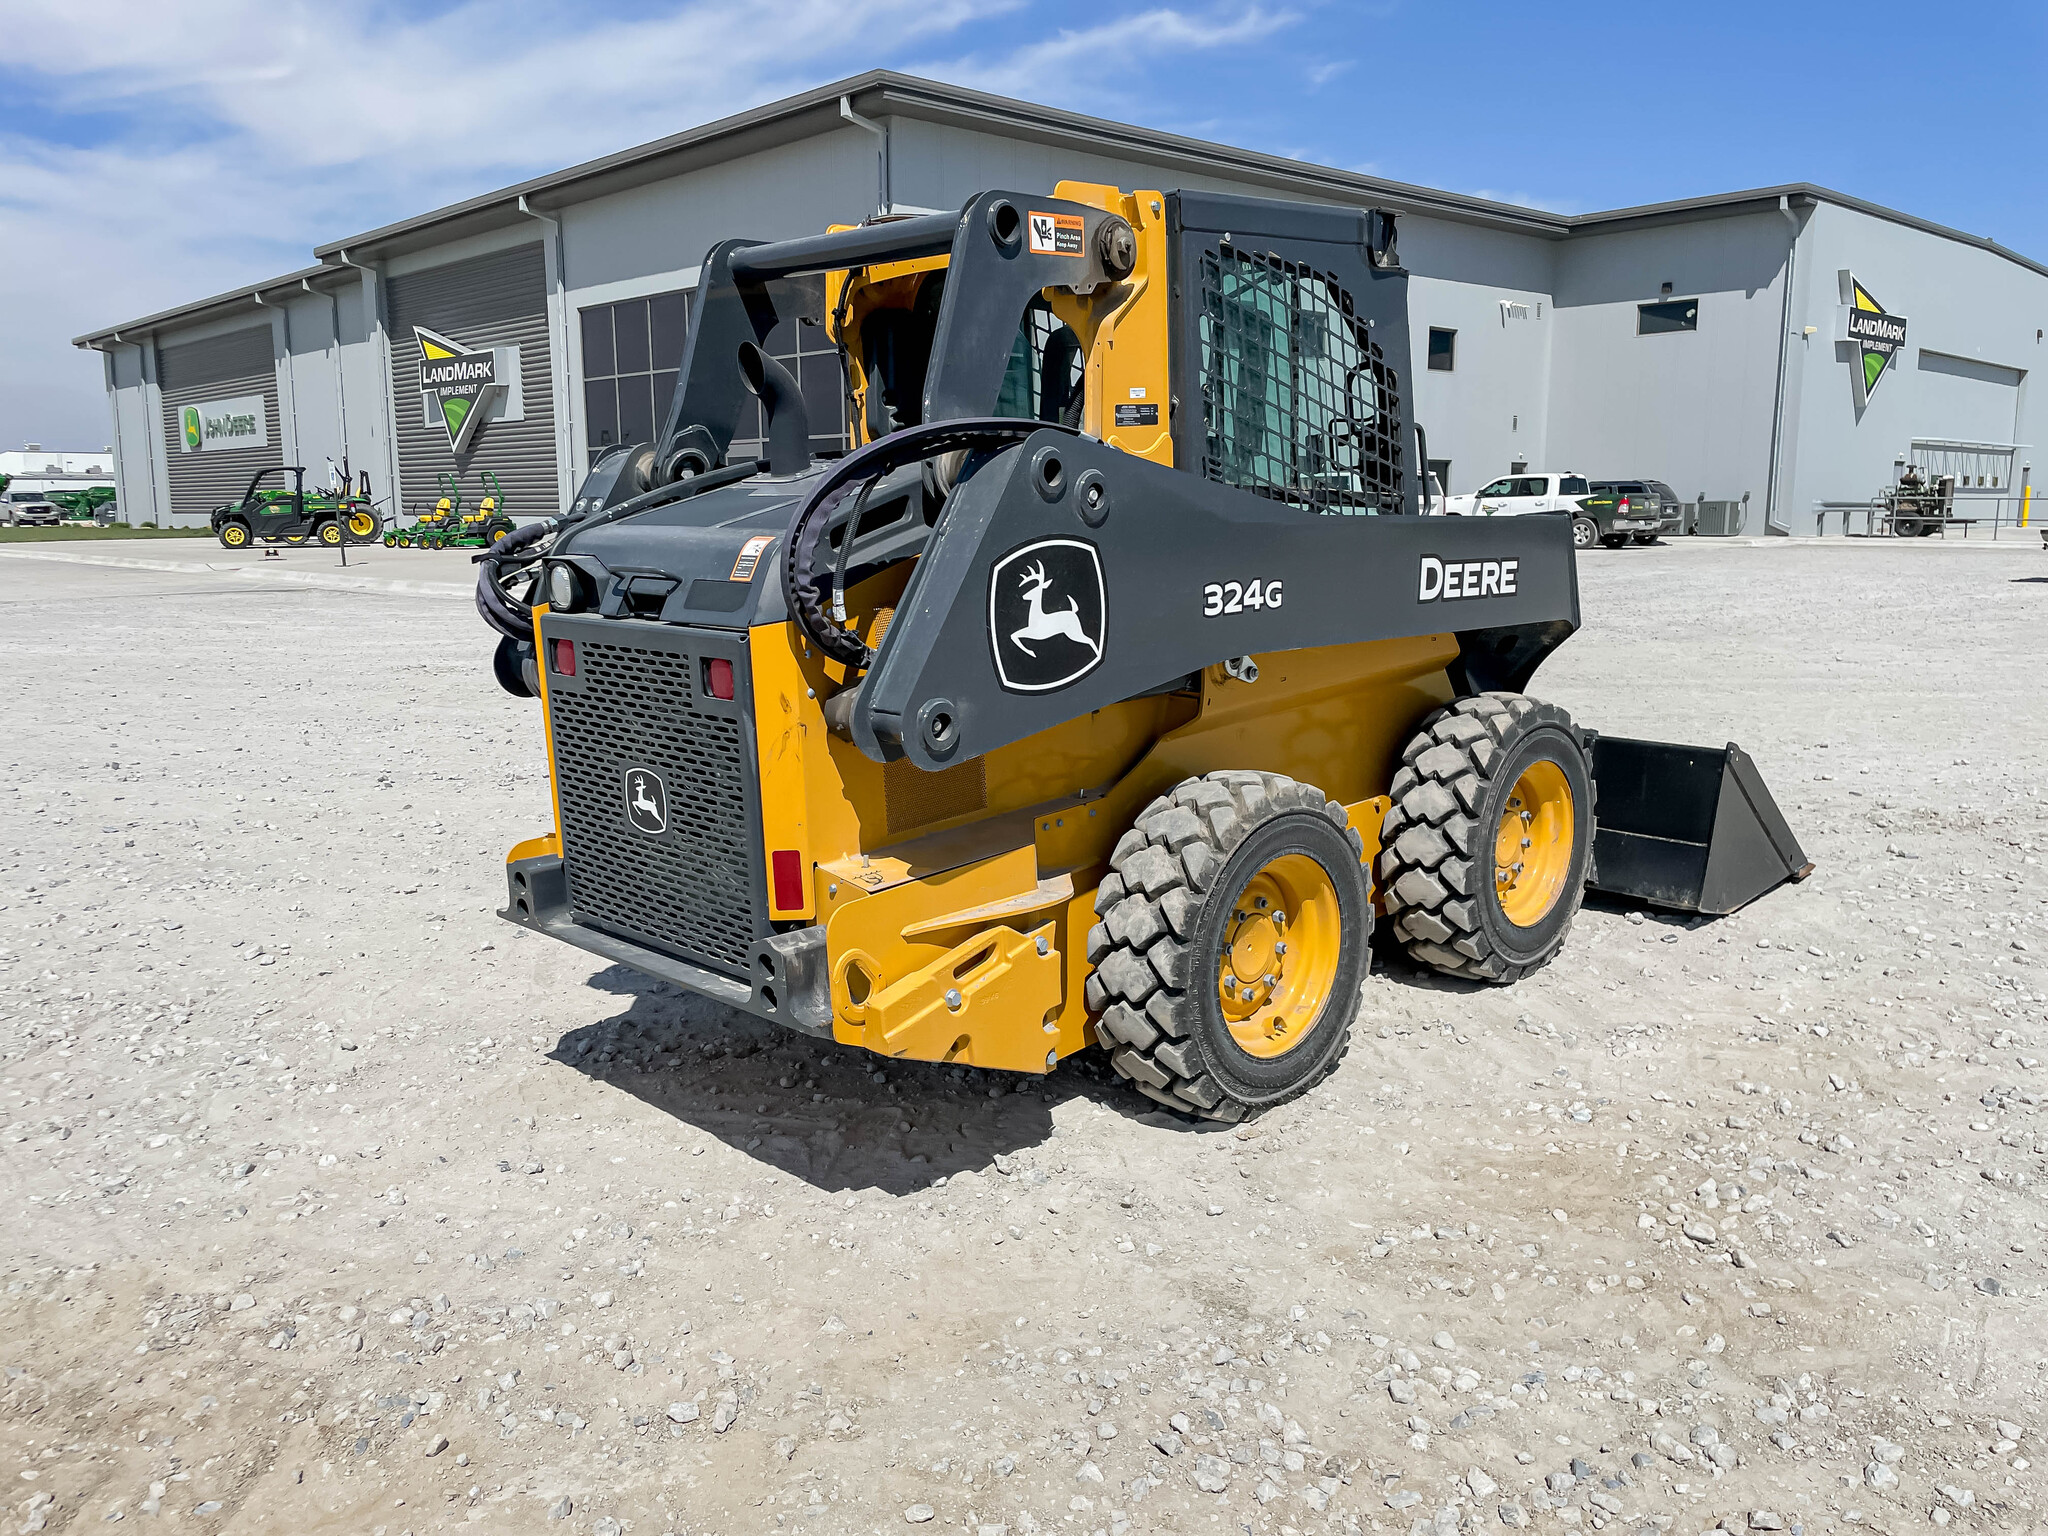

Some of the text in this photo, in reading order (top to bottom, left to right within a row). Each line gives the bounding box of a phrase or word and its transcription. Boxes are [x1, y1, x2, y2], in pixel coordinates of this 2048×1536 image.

[1056, 232, 1069, 240] Pinch
[1057, 241, 1067, 249] Keep
[1862, 340, 1893, 353] IMPLEMENT
[440, 384, 477, 397] IMPLEMENT
[225, 413, 256, 437] DEERE
[1418, 557, 1518, 601] DEERE
[1203, 579, 1283, 617] 324G
